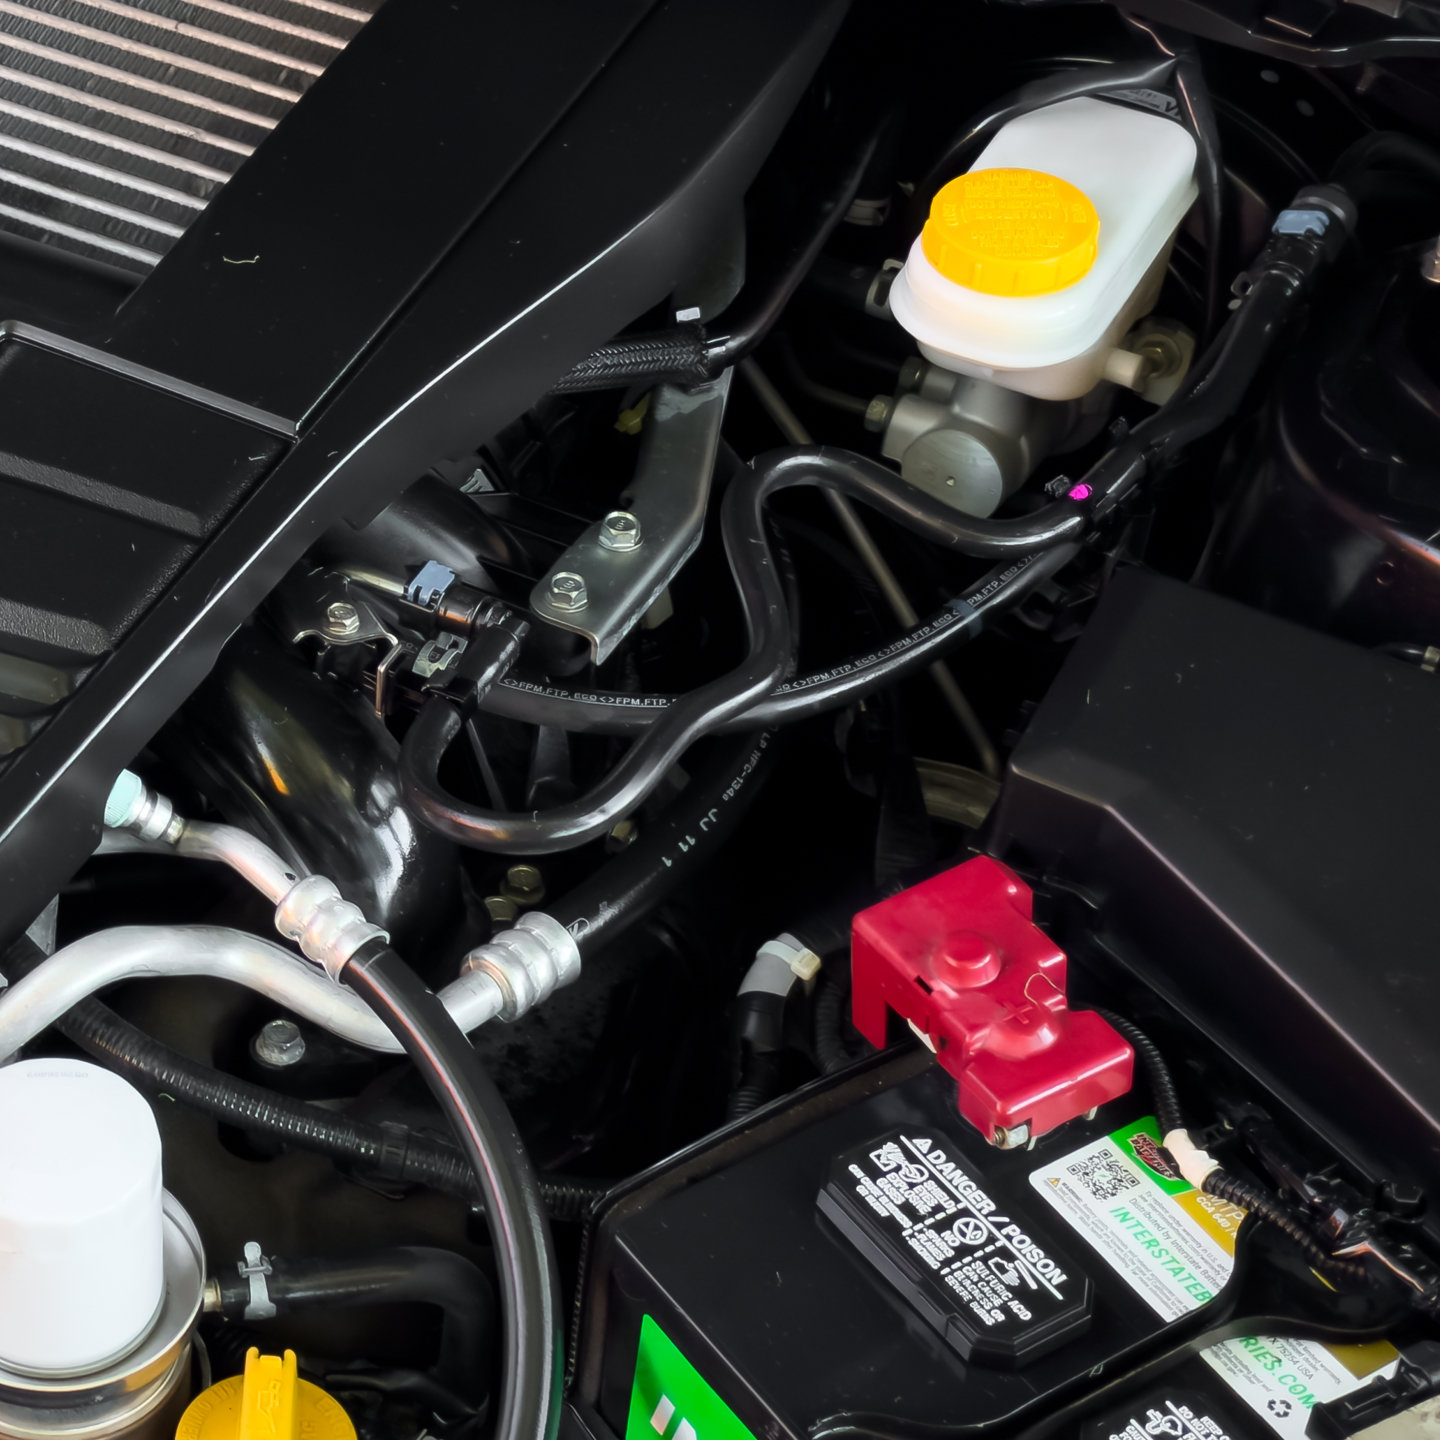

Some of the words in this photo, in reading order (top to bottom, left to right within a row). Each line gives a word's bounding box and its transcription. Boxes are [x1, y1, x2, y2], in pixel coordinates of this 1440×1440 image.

[1193, 1195, 1217, 1214] CCA
[938, 1229, 963, 1248] NO
[958, 1264, 982, 1282] CAN
[973, 1280, 1005, 1307] CAUSE
[967, 1259, 1015, 1301] SULFURIC
[1005, 1298, 1035, 1322] ACID
[1187, 1417, 1211, 1436] NOT
[1197, 1415, 1225, 1437] KEEP
